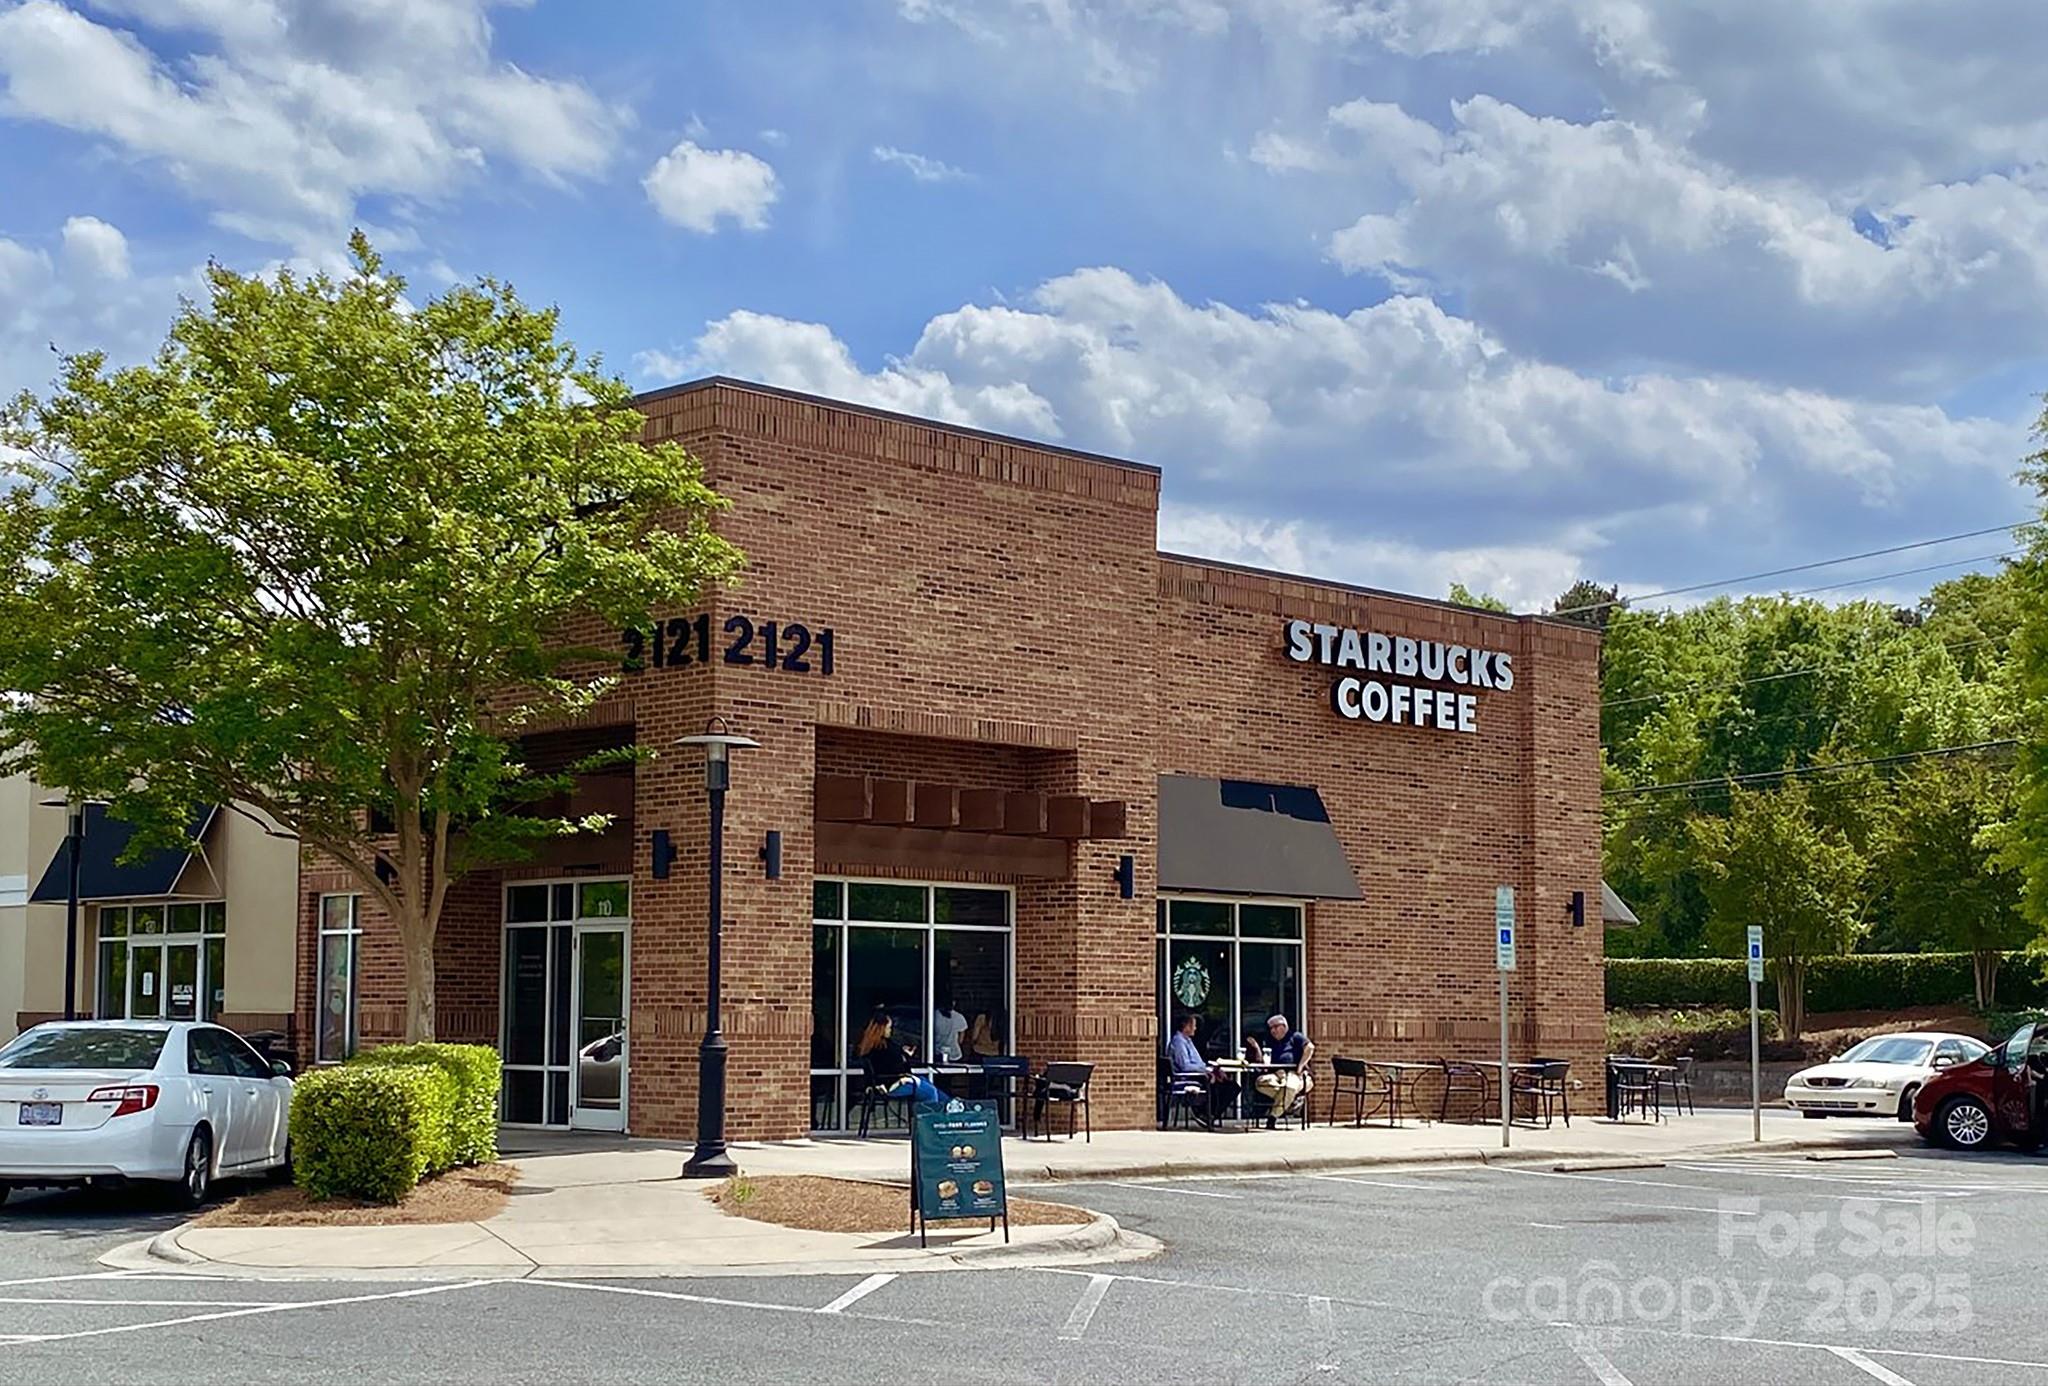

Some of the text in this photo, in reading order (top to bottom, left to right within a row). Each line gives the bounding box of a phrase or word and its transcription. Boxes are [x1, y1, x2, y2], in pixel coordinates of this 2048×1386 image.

[622, 613, 710, 673] 2121
[723, 615, 834, 676] 2121
[1287, 619, 1515, 691] STARBUCKS
[1336, 677, 1478, 733] COFFEE
